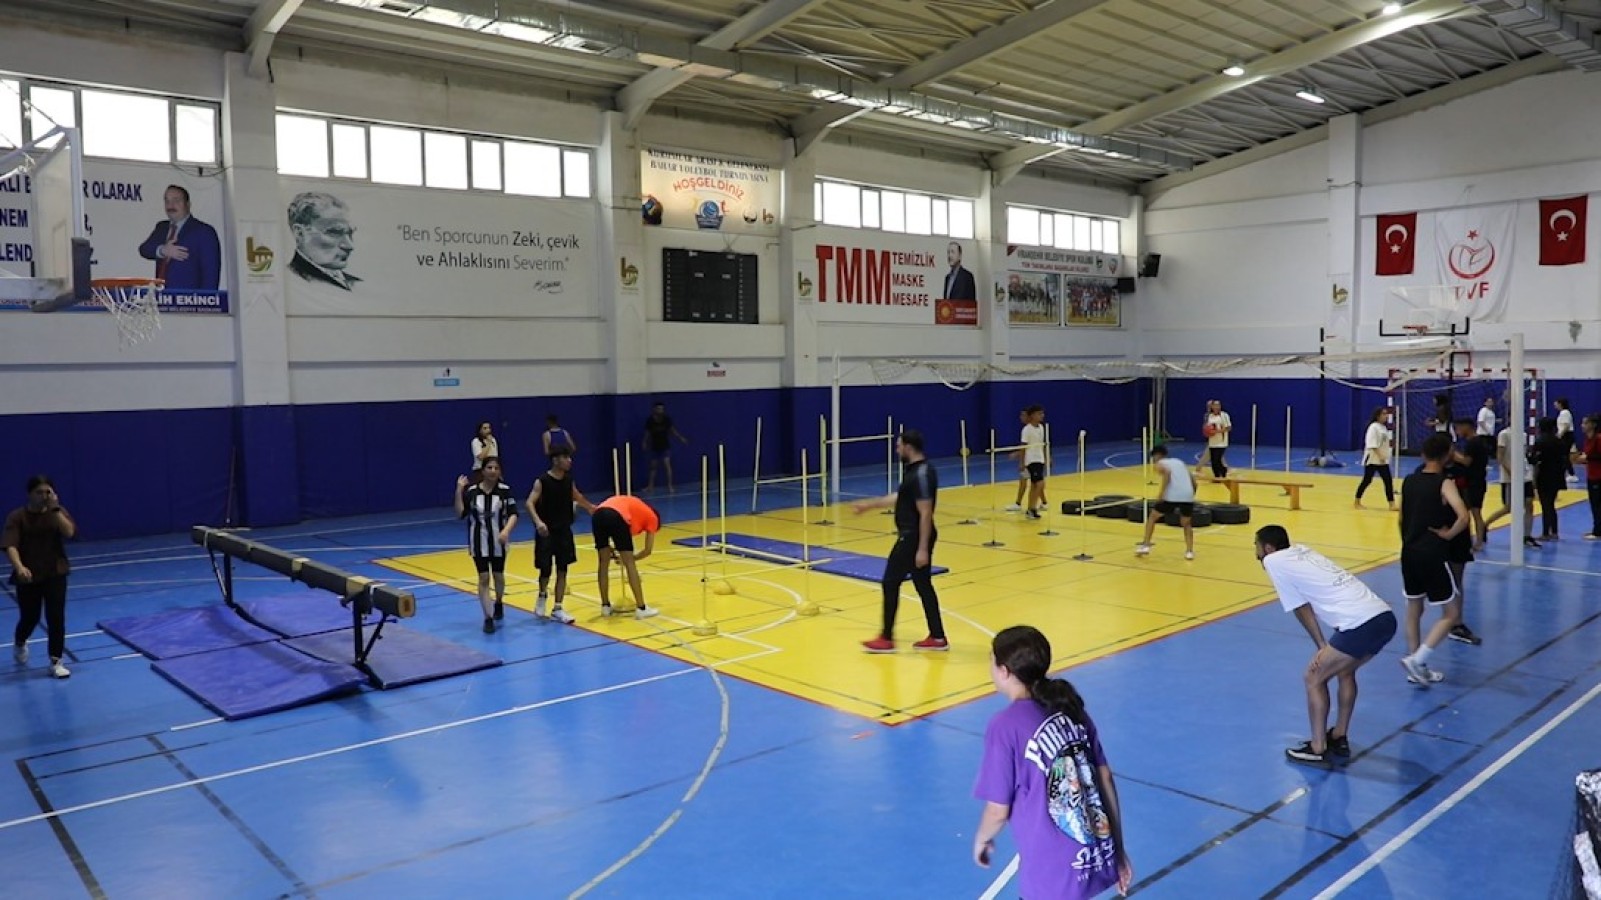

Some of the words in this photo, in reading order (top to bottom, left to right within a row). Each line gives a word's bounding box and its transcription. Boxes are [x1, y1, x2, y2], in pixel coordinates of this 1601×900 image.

[92, 181, 142, 201] OLARAK
[434, 226, 509, 246] Sporcunun
[512, 230, 544, 249] Zeki,
[547, 233, 580, 251] çevik
[416, 253, 434, 266] ve
[438, 252, 510, 269] Ahlaklısını
[892, 249, 935, 268] TEMİZLİK
[815, 244, 891, 306] TMM
[892, 274, 925, 288] MASKE
[176, 293, 220, 306] EKİNCİ
[892, 293, 929, 307] MESAFE
[1454, 282, 1490, 300] TVF
